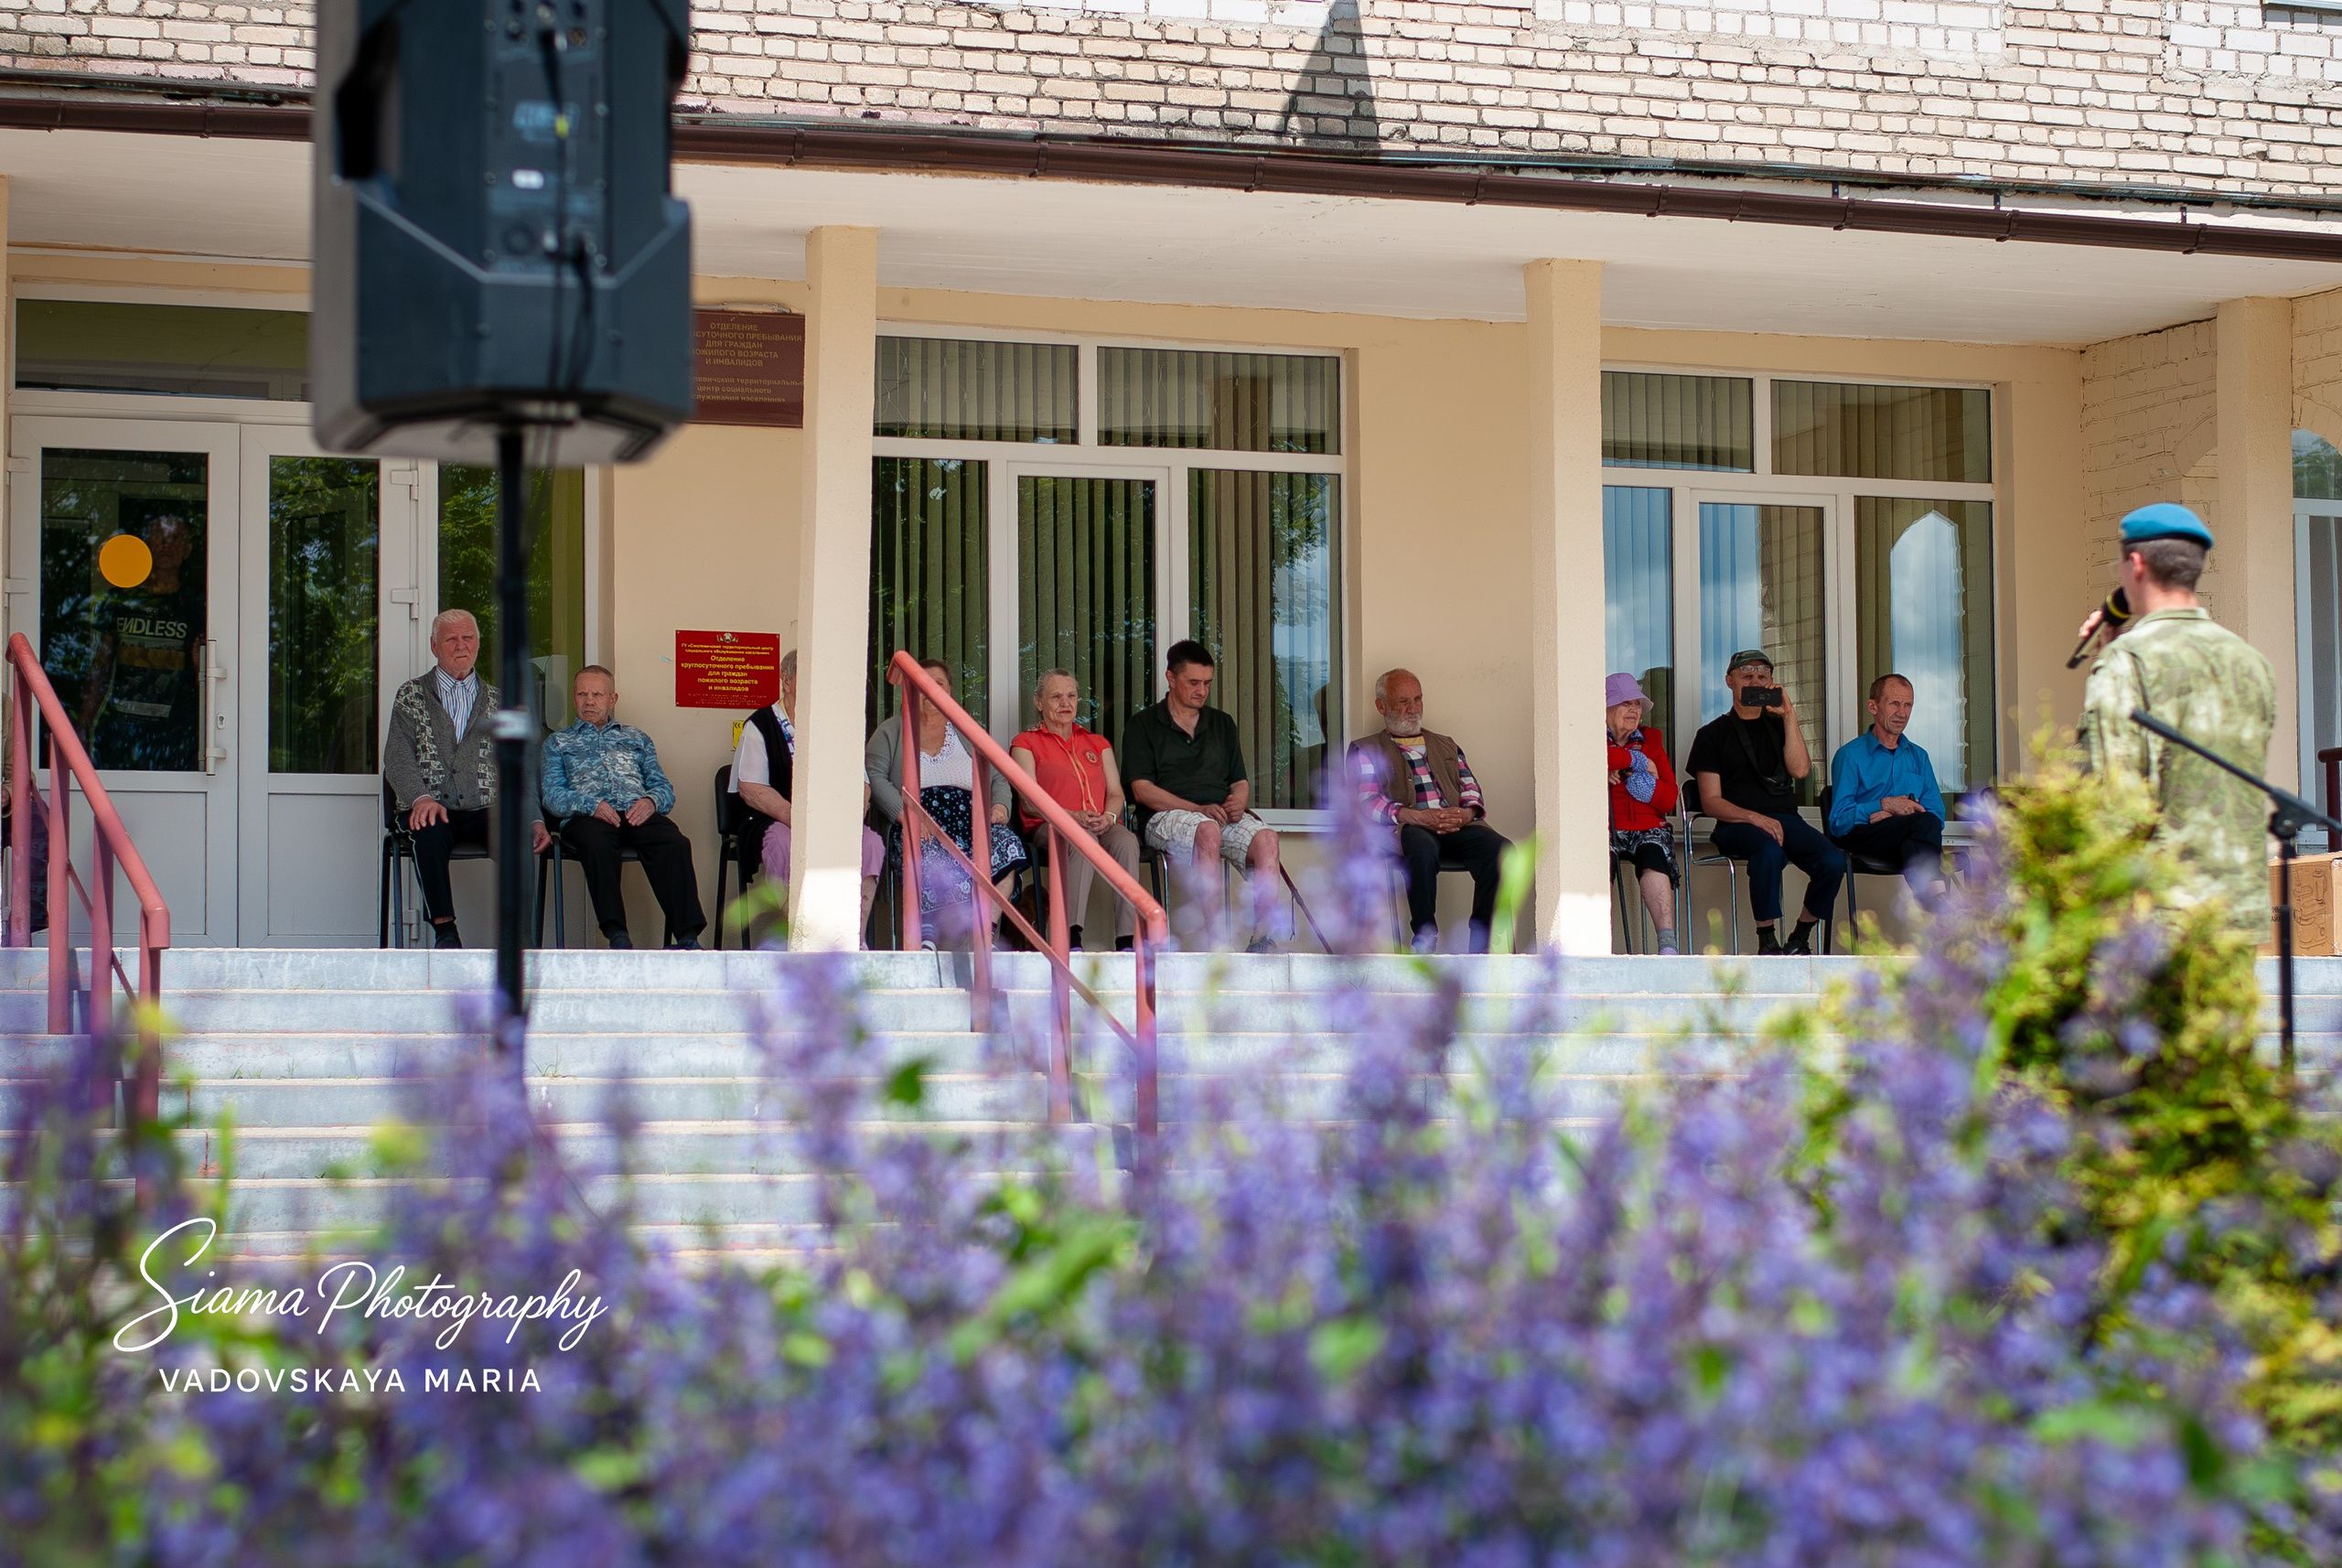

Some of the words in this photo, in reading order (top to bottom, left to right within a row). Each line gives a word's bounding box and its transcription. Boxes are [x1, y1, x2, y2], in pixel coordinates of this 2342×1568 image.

[710, 322, 758, 331] ОТДЕЛЕНИЕ
[693, 331, 745, 339] СУТОЧНОГО
[746, 332, 802, 341] ПРЕБЫВАНИЯ
[724, 340, 763, 349] ГРАЖДАН
[737, 350, 779, 359] ВОЗРАСТА
[713, 359, 764, 367] ИНВАЛИДОВ
[697, 385, 720, 393] центр
[721, 386, 772, 394] социального
